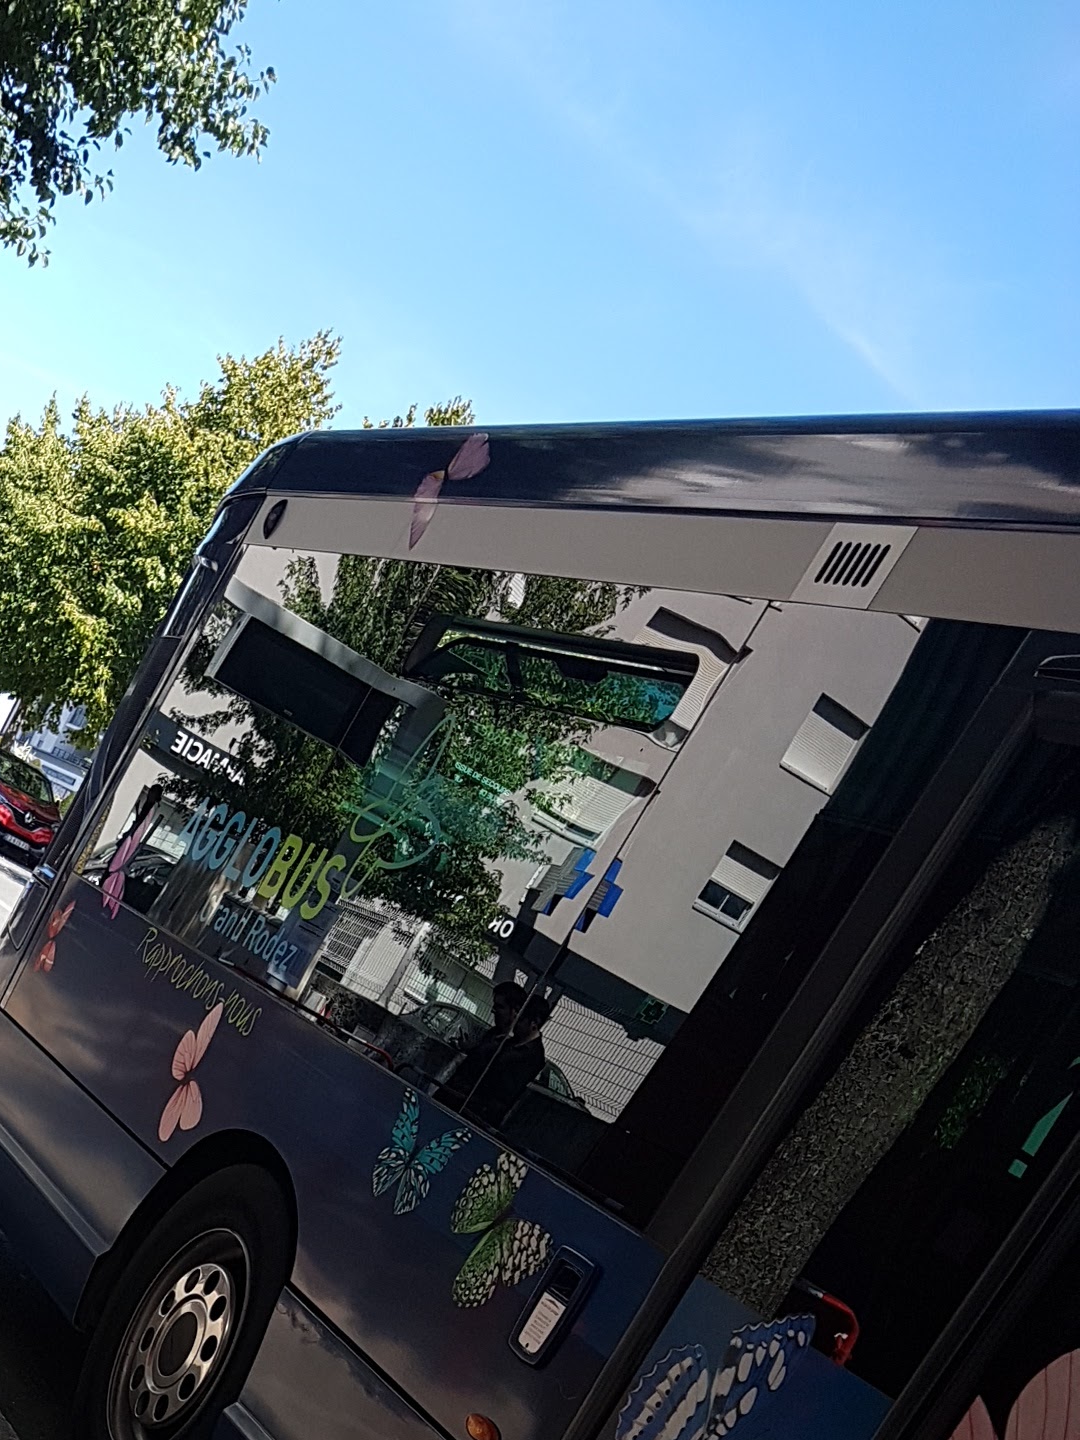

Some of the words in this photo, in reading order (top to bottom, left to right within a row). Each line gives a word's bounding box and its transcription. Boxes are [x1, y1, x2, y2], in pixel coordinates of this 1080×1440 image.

[472, 771, 482, 781] DE
[172, 797, 347, 920] AGGLOBUS
[199, 892, 254, 943] Grand
[242, 912, 298, 972] Rodez
